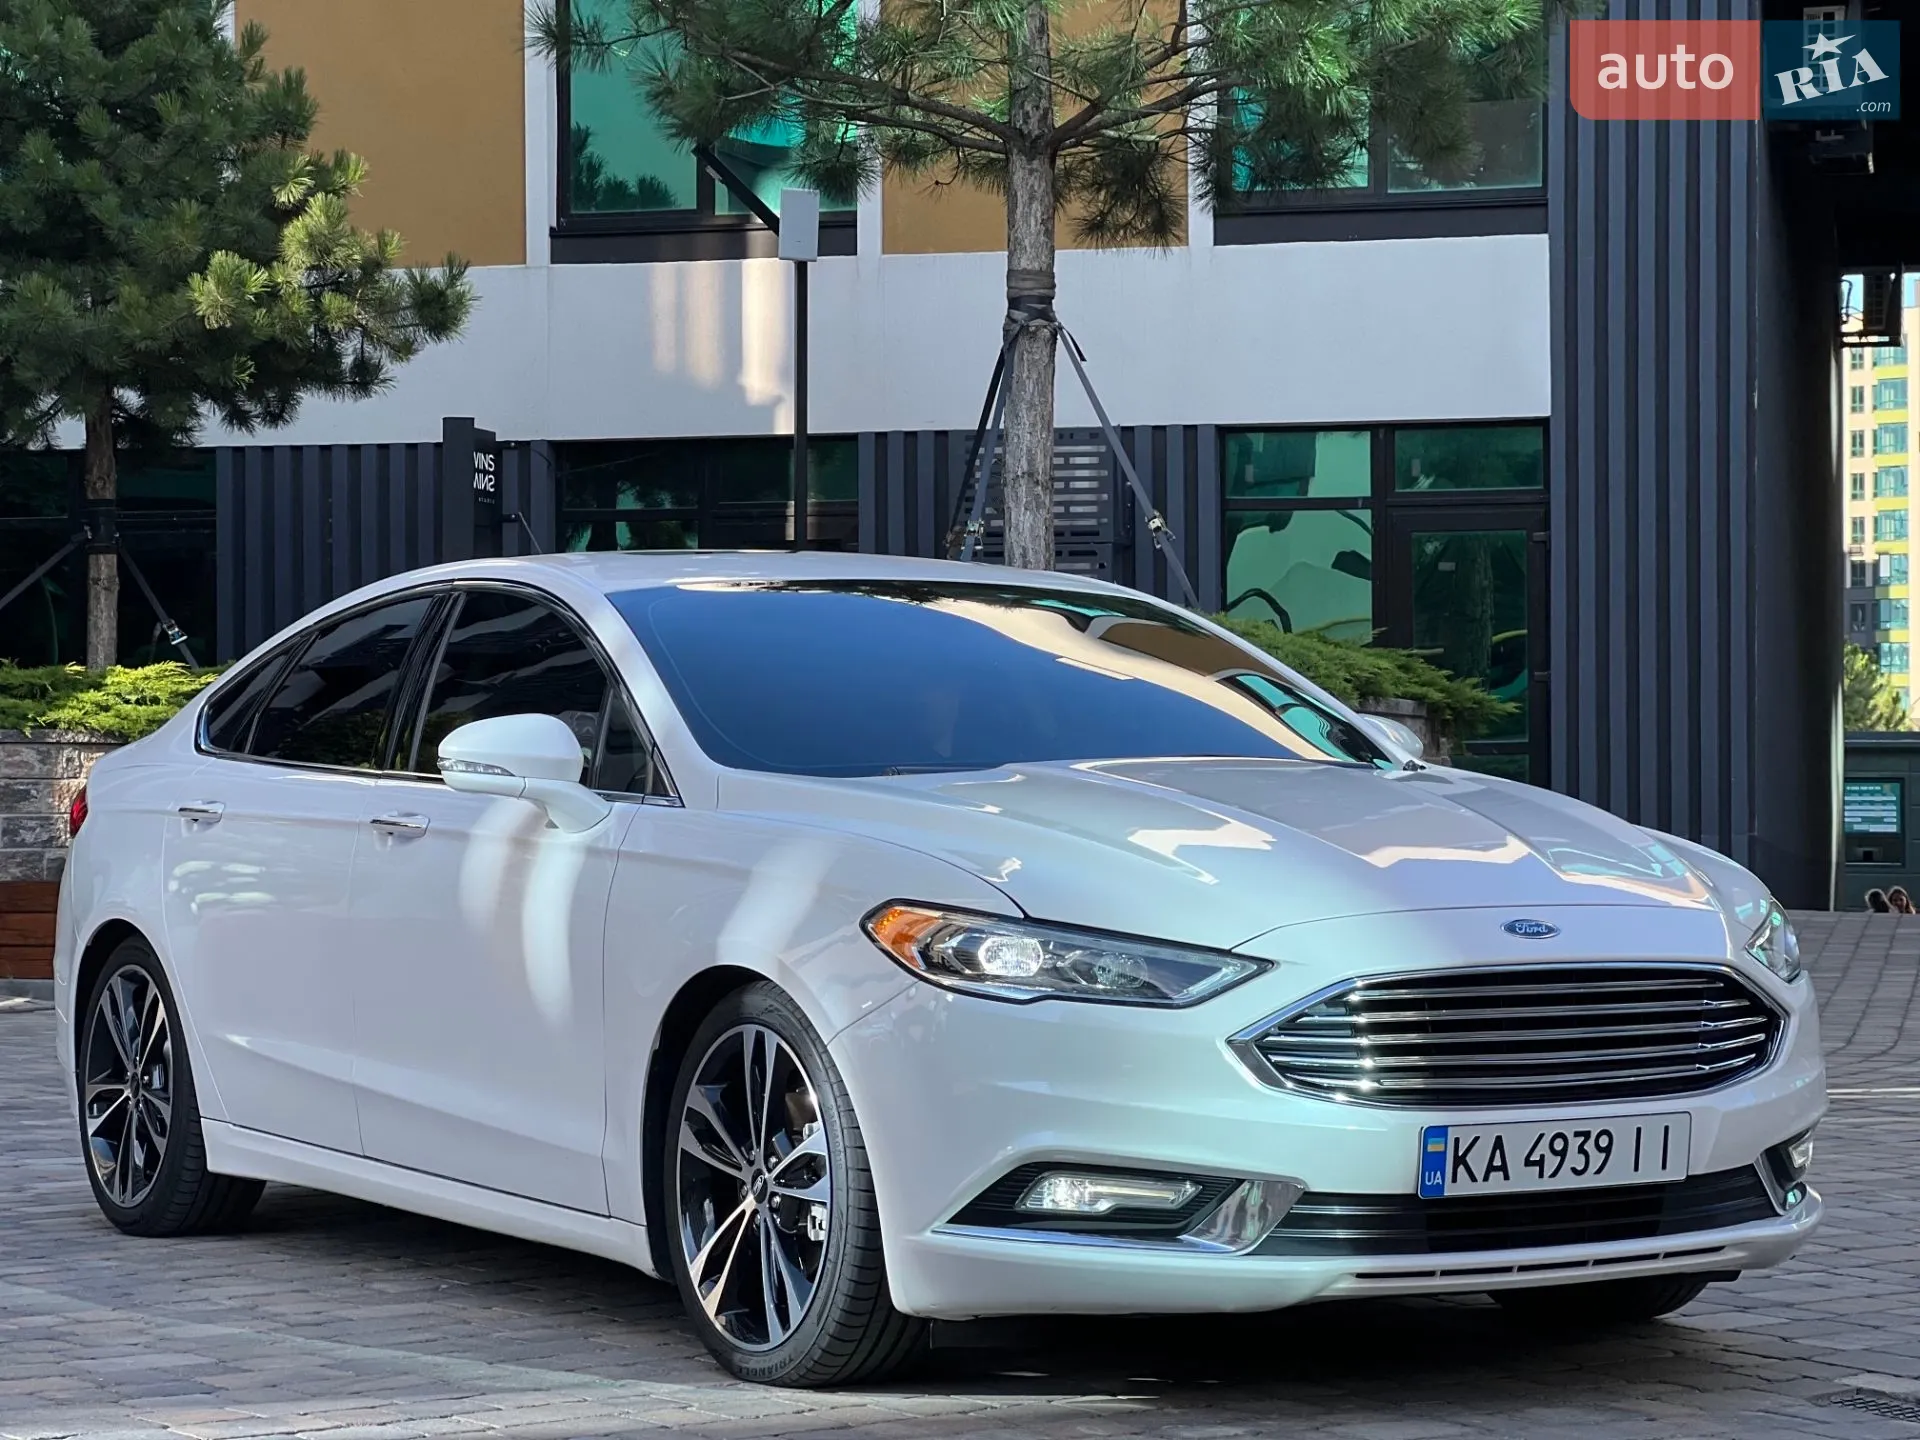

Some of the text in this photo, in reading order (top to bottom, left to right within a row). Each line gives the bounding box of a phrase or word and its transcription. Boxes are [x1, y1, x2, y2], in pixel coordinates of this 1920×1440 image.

[473, 451, 495, 471] VINS
[1515, 922, 1548, 933] Ford
[1451, 1135, 1510, 1183] KA
[1524, 1129, 1614, 1179] 4939
[1425, 1170, 1442, 1186] UA
